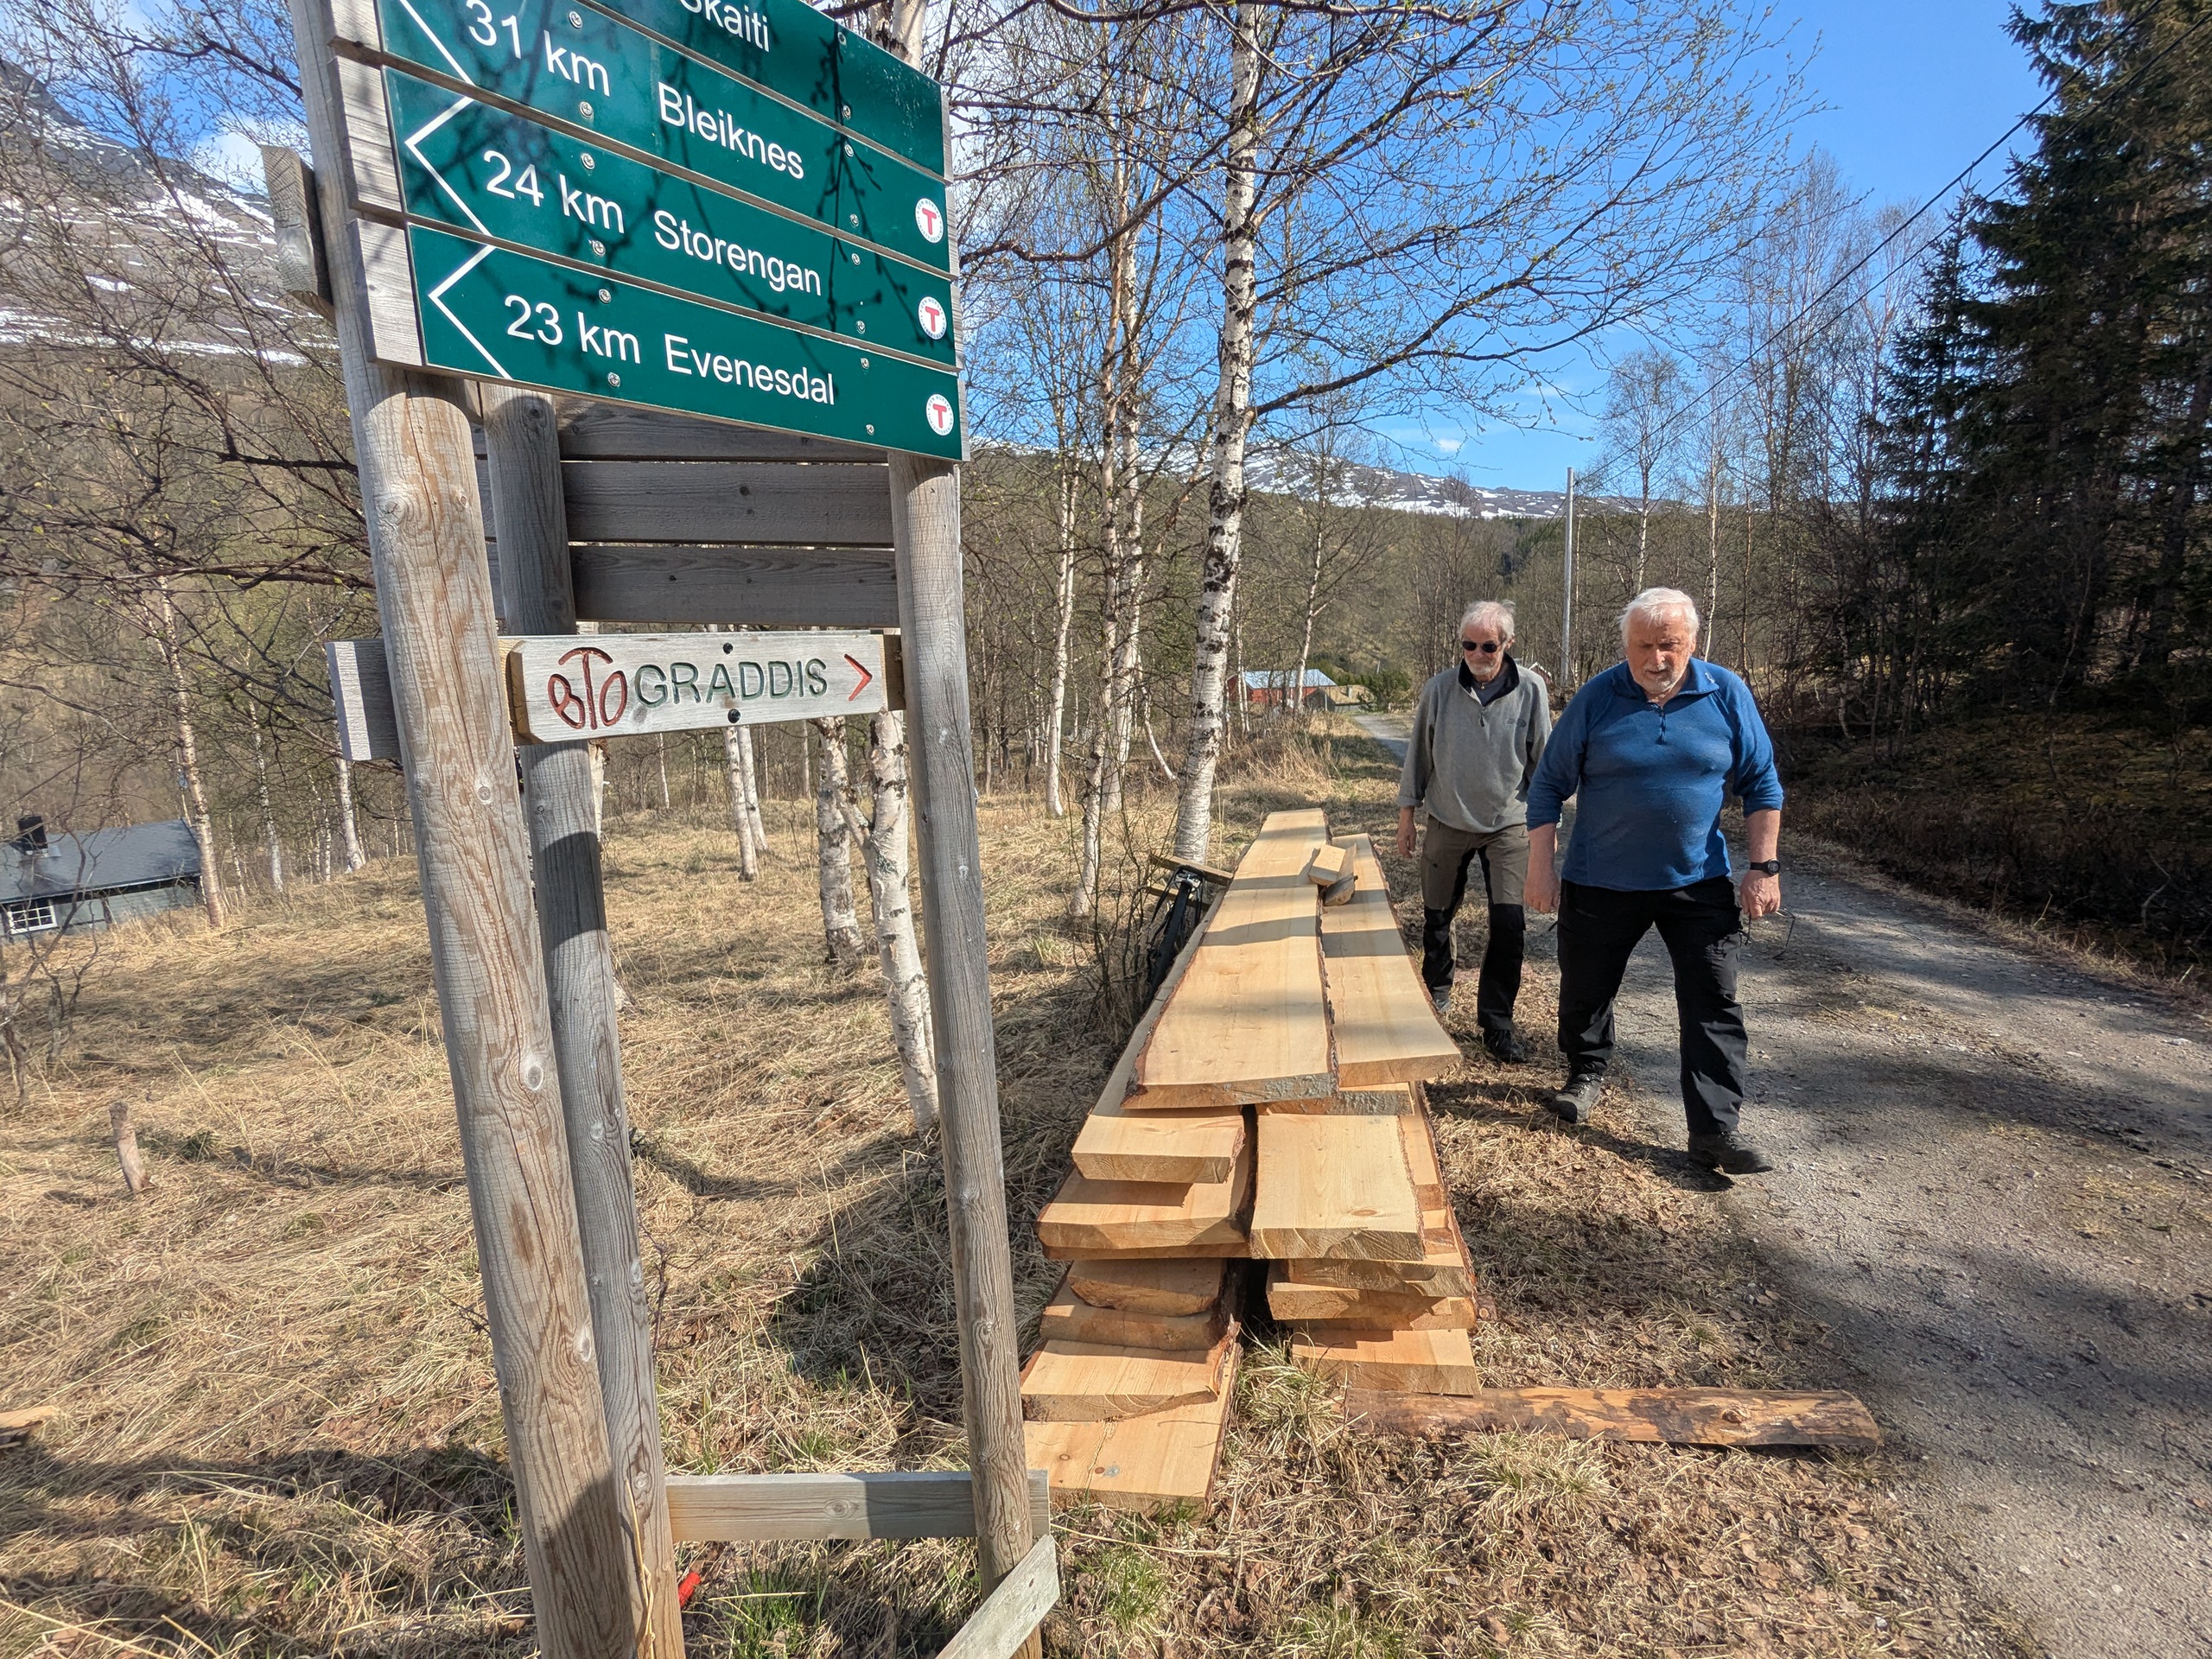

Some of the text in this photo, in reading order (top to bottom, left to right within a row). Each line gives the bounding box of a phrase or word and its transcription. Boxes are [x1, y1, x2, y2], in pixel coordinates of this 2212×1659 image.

[466, 0, 804, 180] 31 km Bleiknes
[484, 149, 821, 296] 24 km Storengan
[505, 295, 835, 405] 23 km Evenesdal
[634, 658, 828, 708] GRADDIS
